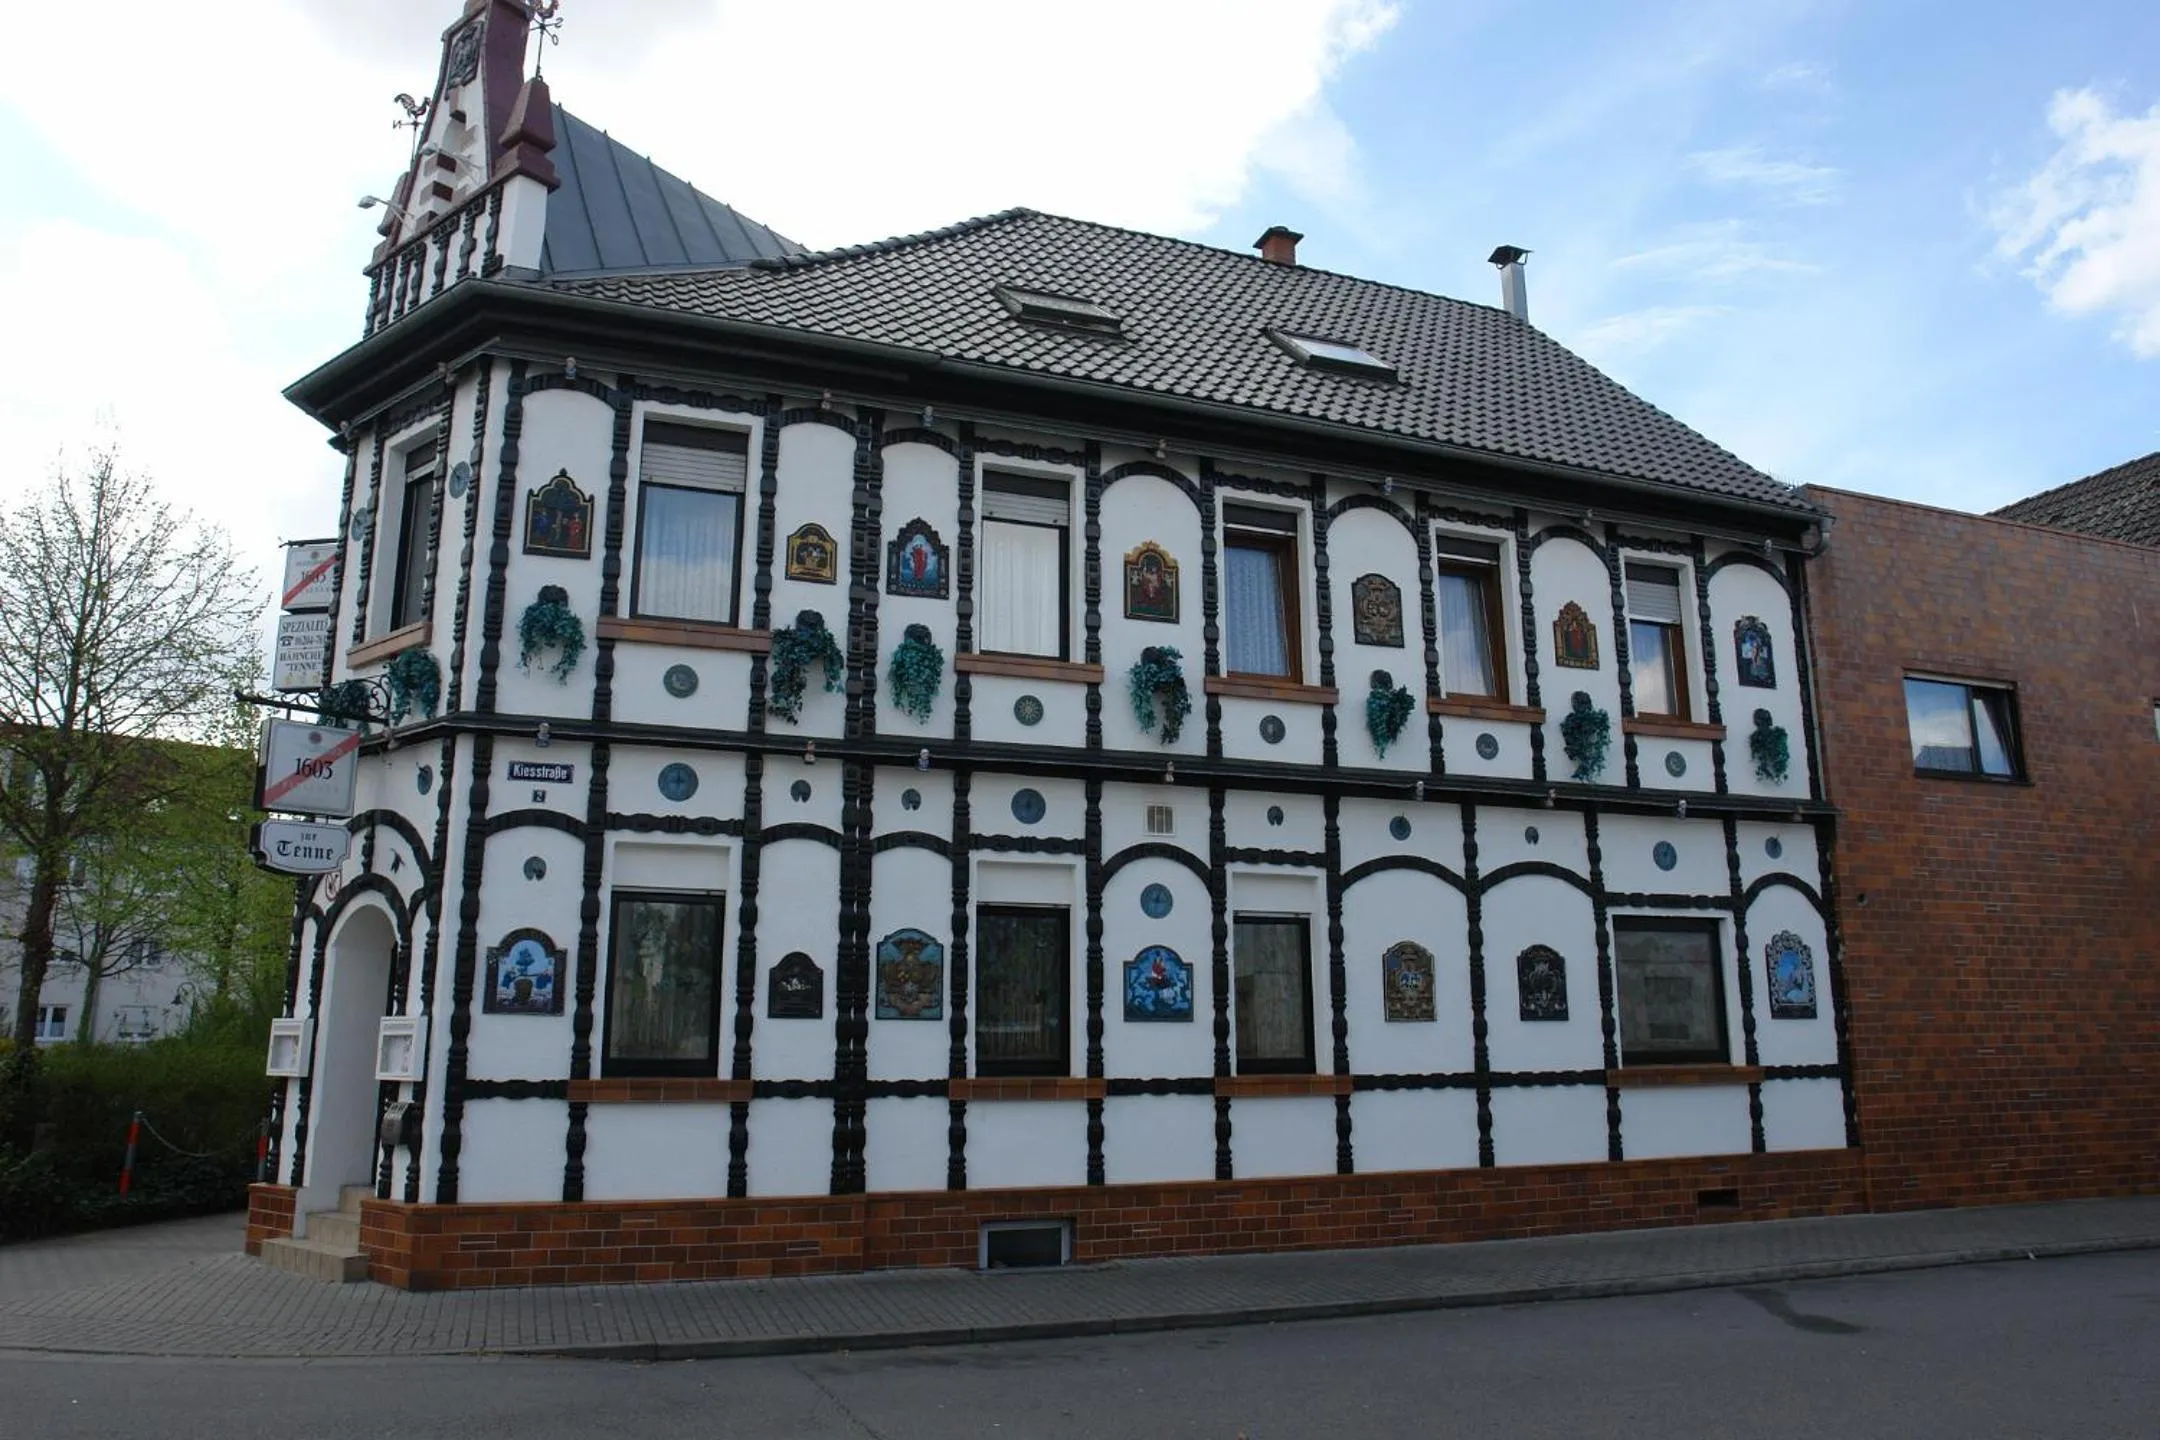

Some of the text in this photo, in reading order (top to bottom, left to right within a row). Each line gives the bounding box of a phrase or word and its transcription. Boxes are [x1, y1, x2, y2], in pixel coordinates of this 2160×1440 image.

[295, 757, 333, 780] 1603
[513, 763, 568, 780] Kiesstraße
[276, 840, 334, 861] Tenne
